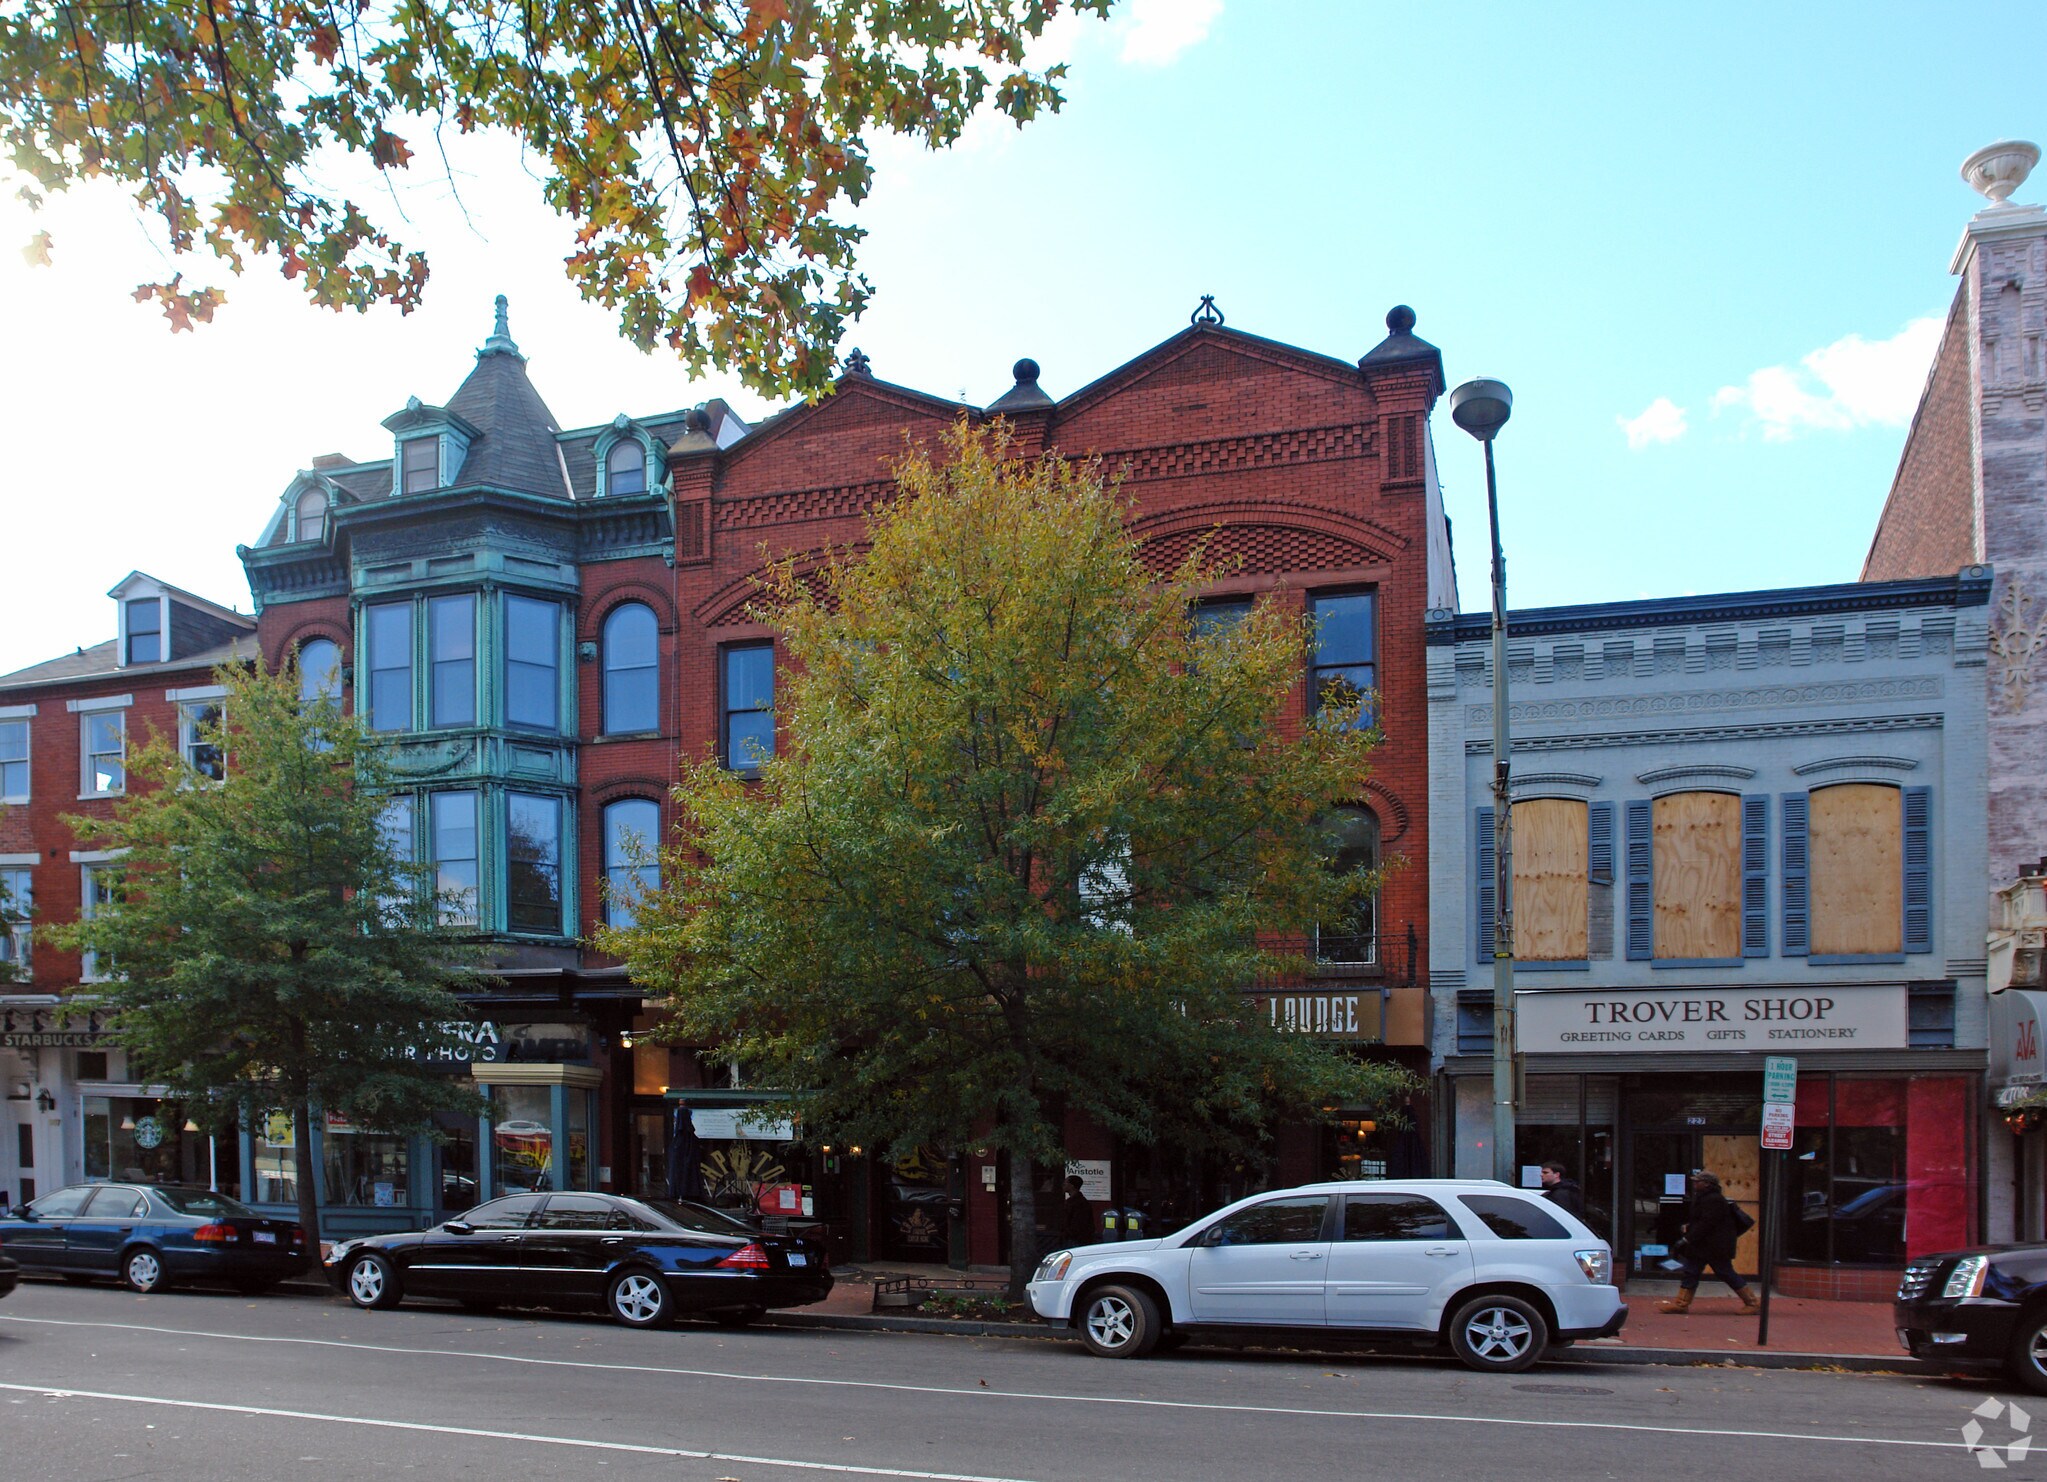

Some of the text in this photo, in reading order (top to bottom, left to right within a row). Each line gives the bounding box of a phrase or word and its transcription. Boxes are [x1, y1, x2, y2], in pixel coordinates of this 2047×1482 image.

[1584, 997, 1835, 1024] TROVER SHOP
[4, 1033, 92, 1047] STARBUCKS
[1560, 1027, 1858, 1042] GREETING CARDS GIFTS STATIONERY
[1688, 1117, 1705, 1125] 227
